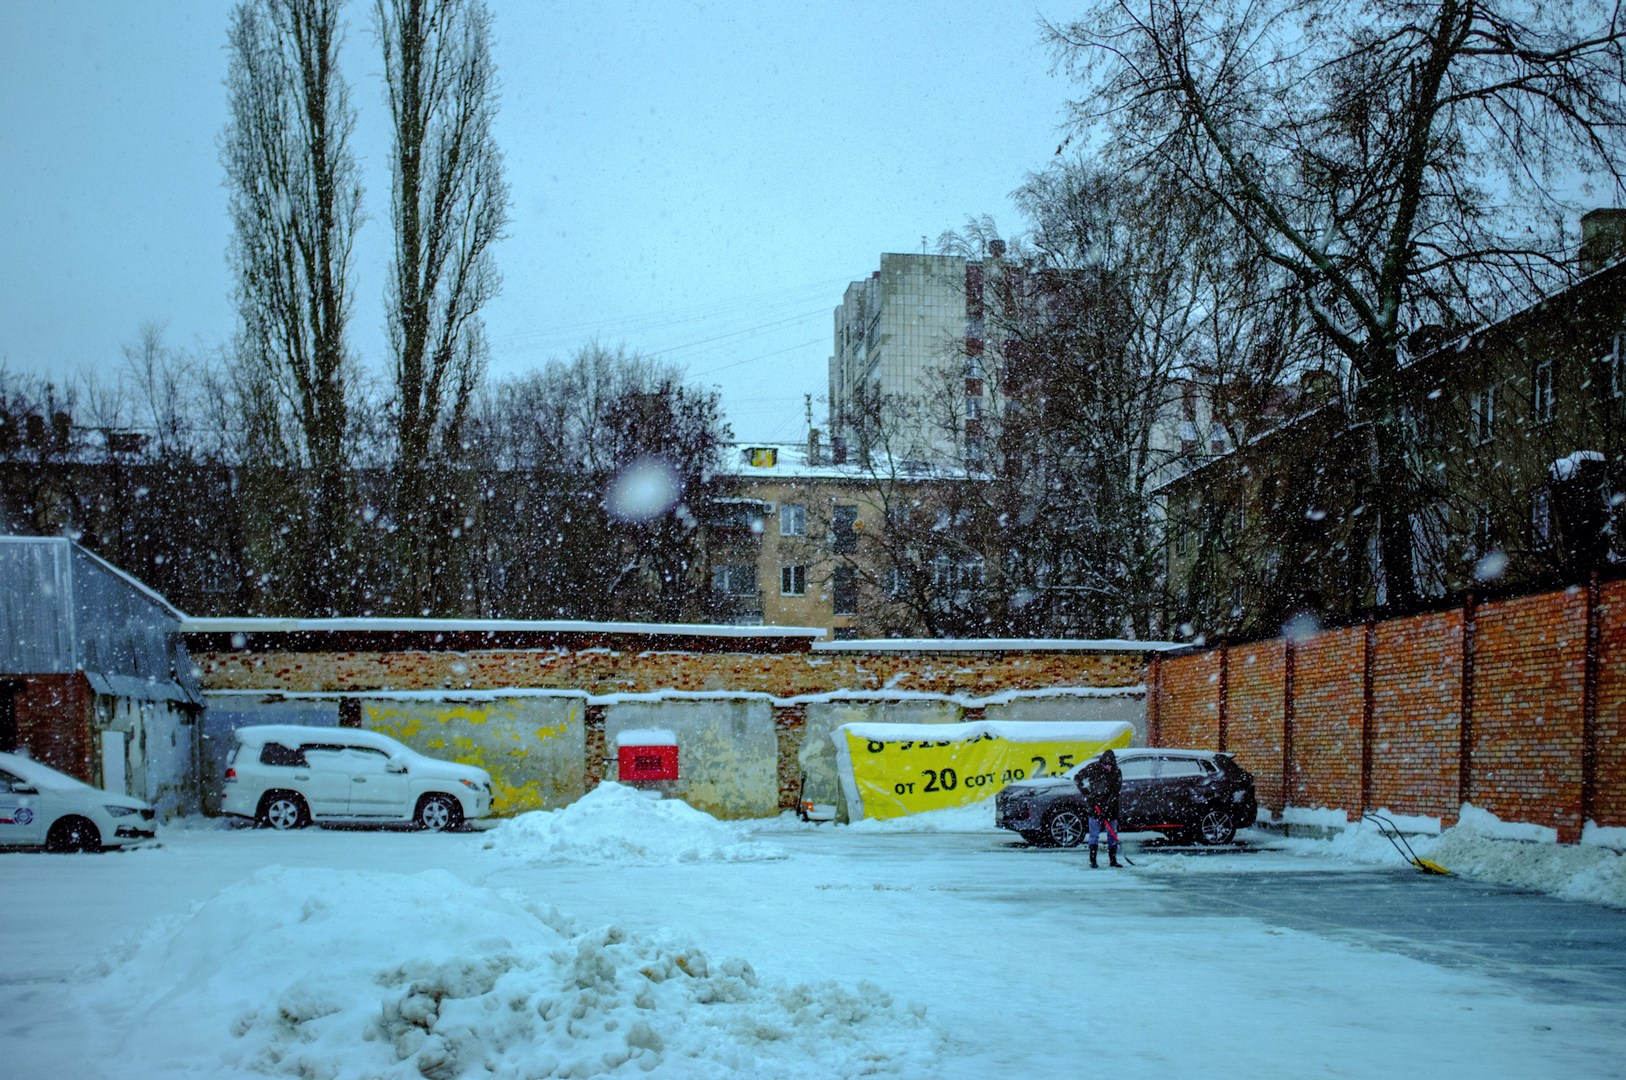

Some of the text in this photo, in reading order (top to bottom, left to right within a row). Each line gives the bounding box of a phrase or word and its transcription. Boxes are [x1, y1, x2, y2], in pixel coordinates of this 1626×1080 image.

[895, 783, 915, 795] от
[922, 768, 957, 792] 20
[965, 772, 995, 788] сот
[1002, 769, 1024, 784] до
